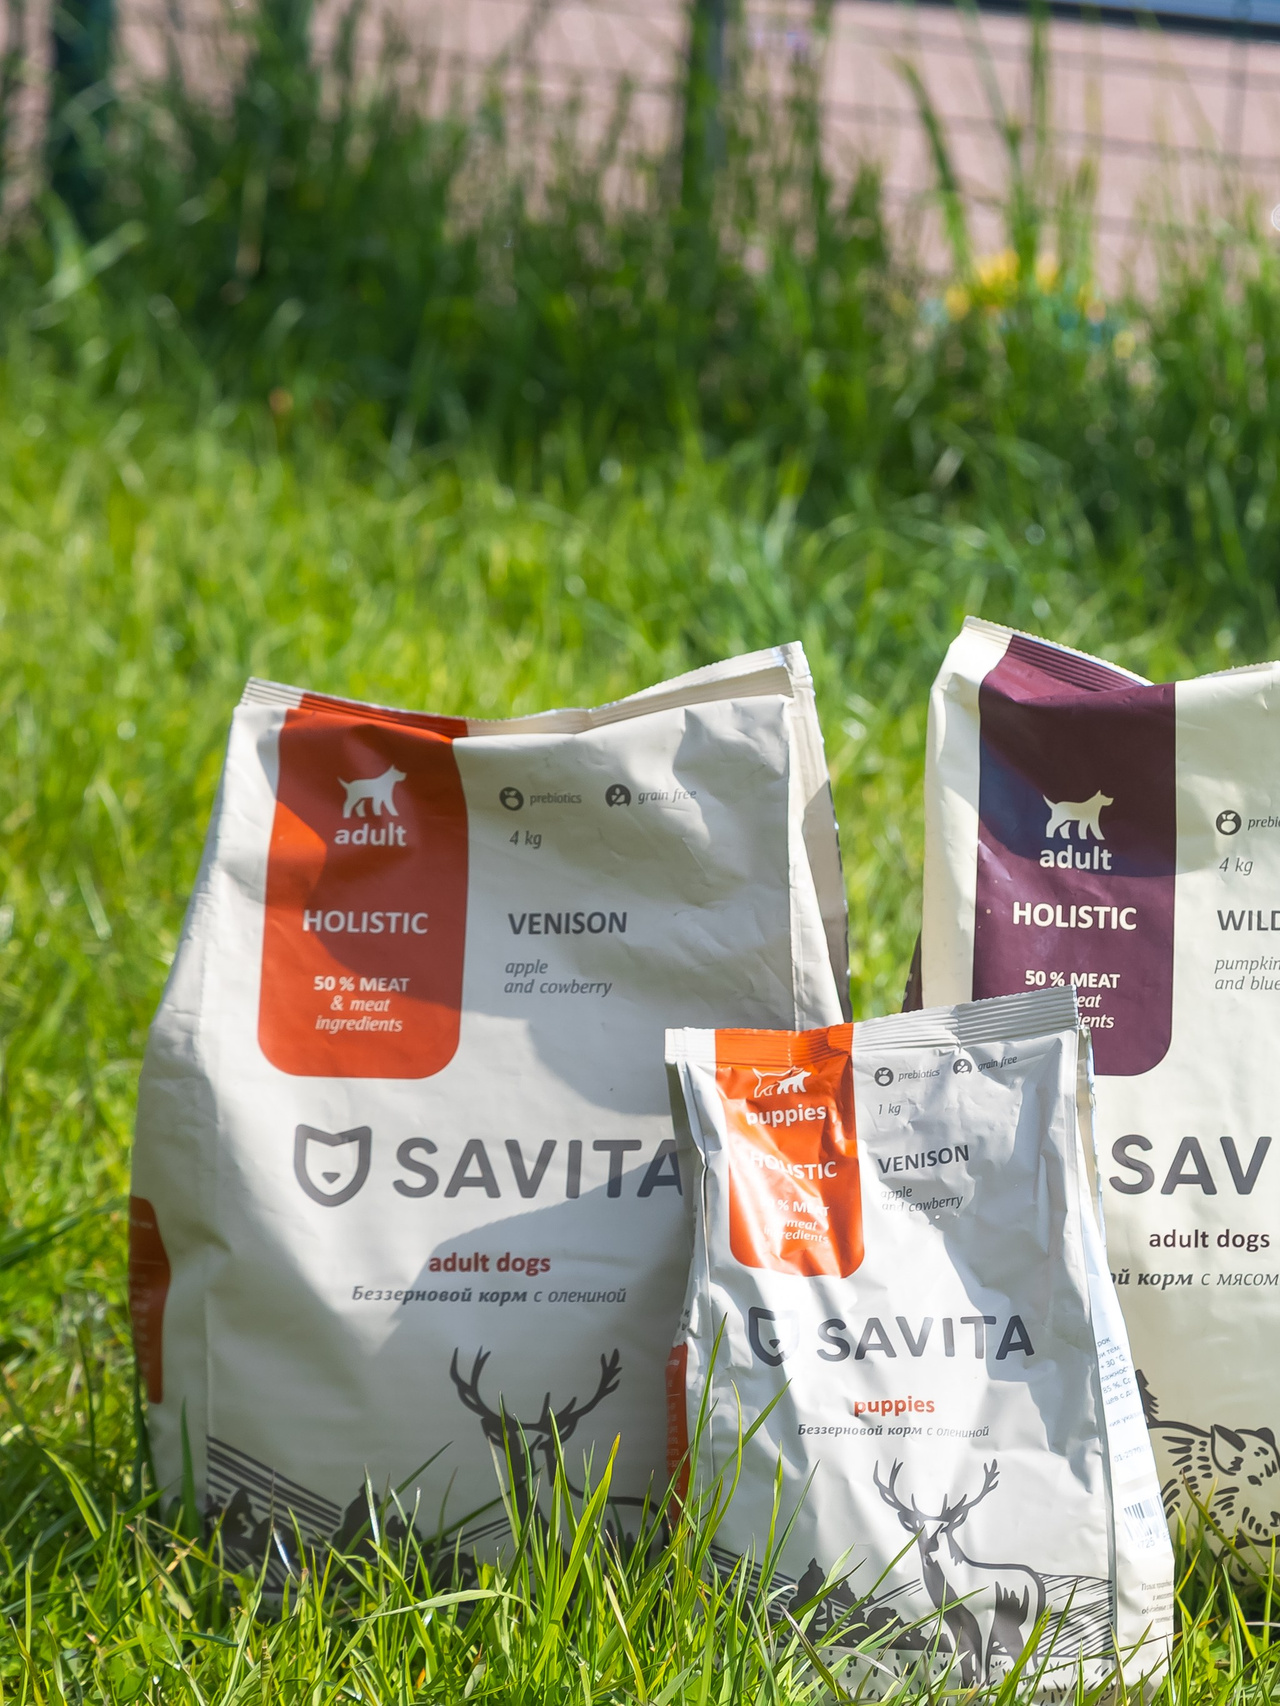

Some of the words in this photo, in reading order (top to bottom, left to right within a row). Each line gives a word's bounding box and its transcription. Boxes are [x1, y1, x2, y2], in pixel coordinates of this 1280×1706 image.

[529, 793, 582, 806] prebiotics
[638, 790, 669, 805] grain
[672, 788, 697, 803] free
[334, 822, 407, 847] adult
[509, 830, 520, 845] 4
[525, 830, 542, 850] kg
[1039, 844, 1112, 871] adult
[1219, 857, 1231, 873] 4
[1235, 857, 1254, 877] kg
[302, 909, 429, 935] HOLISTIC
[508, 911, 628, 935] VENISON
[1012, 901, 1137, 931] HOLISTIC
[505, 959, 548, 977] apple
[313, 975, 336, 992] 50
[339, 976, 355, 992] %
[359, 976, 410, 993] MEAT
[504, 979, 533, 994] and
[540, 979, 612, 997] cowberry
[1024, 970, 1046, 986] 50
[1050, 971, 1065, 986] %
[1070, 972, 1120, 989] MEAT
[1214, 975, 1244, 991] and
[330, 995, 344, 1012] &
[350, 998, 391, 1013] meat
[1077, 994, 1102, 1008] eat
[315, 1015, 403, 1034] ingredients
[978, 1059, 998, 1072] grain
[999, 1056, 1018, 1069] free
[898, 1069, 940, 1082] prebiotics
[746, 1104, 827, 1128] puppies
[878, 1104, 883, 1115] 1
[888, 1103, 901, 1116] kg
[392, 1137, 683, 1199] SAVITA
[878, 1144, 970, 1174] VENISON
[881, 1186, 913, 1201] apple
[909, 1195, 964, 1212] cowberry
[786, 1219, 817, 1232] meat
[1149, 1229, 1209, 1249] adult
[1217, 1229, 1270, 1252] dogs
[429, 1252, 490, 1272] adult
[496, 1252, 551, 1277] dogs
[1137, 1272, 1194, 1291] корм
[1201, 1273, 1211, 1286] с
[1216, 1273, 1280, 1286] мясом
[352, 1286, 472, 1305] Беззерновой
[478, 1290, 528, 1306] корм
[533, 1291, 543, 1303] с
[547, 1288, 627, 1304] олениной
[816, 1315, 1035, 1360] SAVITA
[854, 1396, 935, 1417] puppies
[798, 1424, 883, 1438] Беззерновой
[887, 1425, 922, 1438] корм
[937, 1425, 990, 1438] олениной
